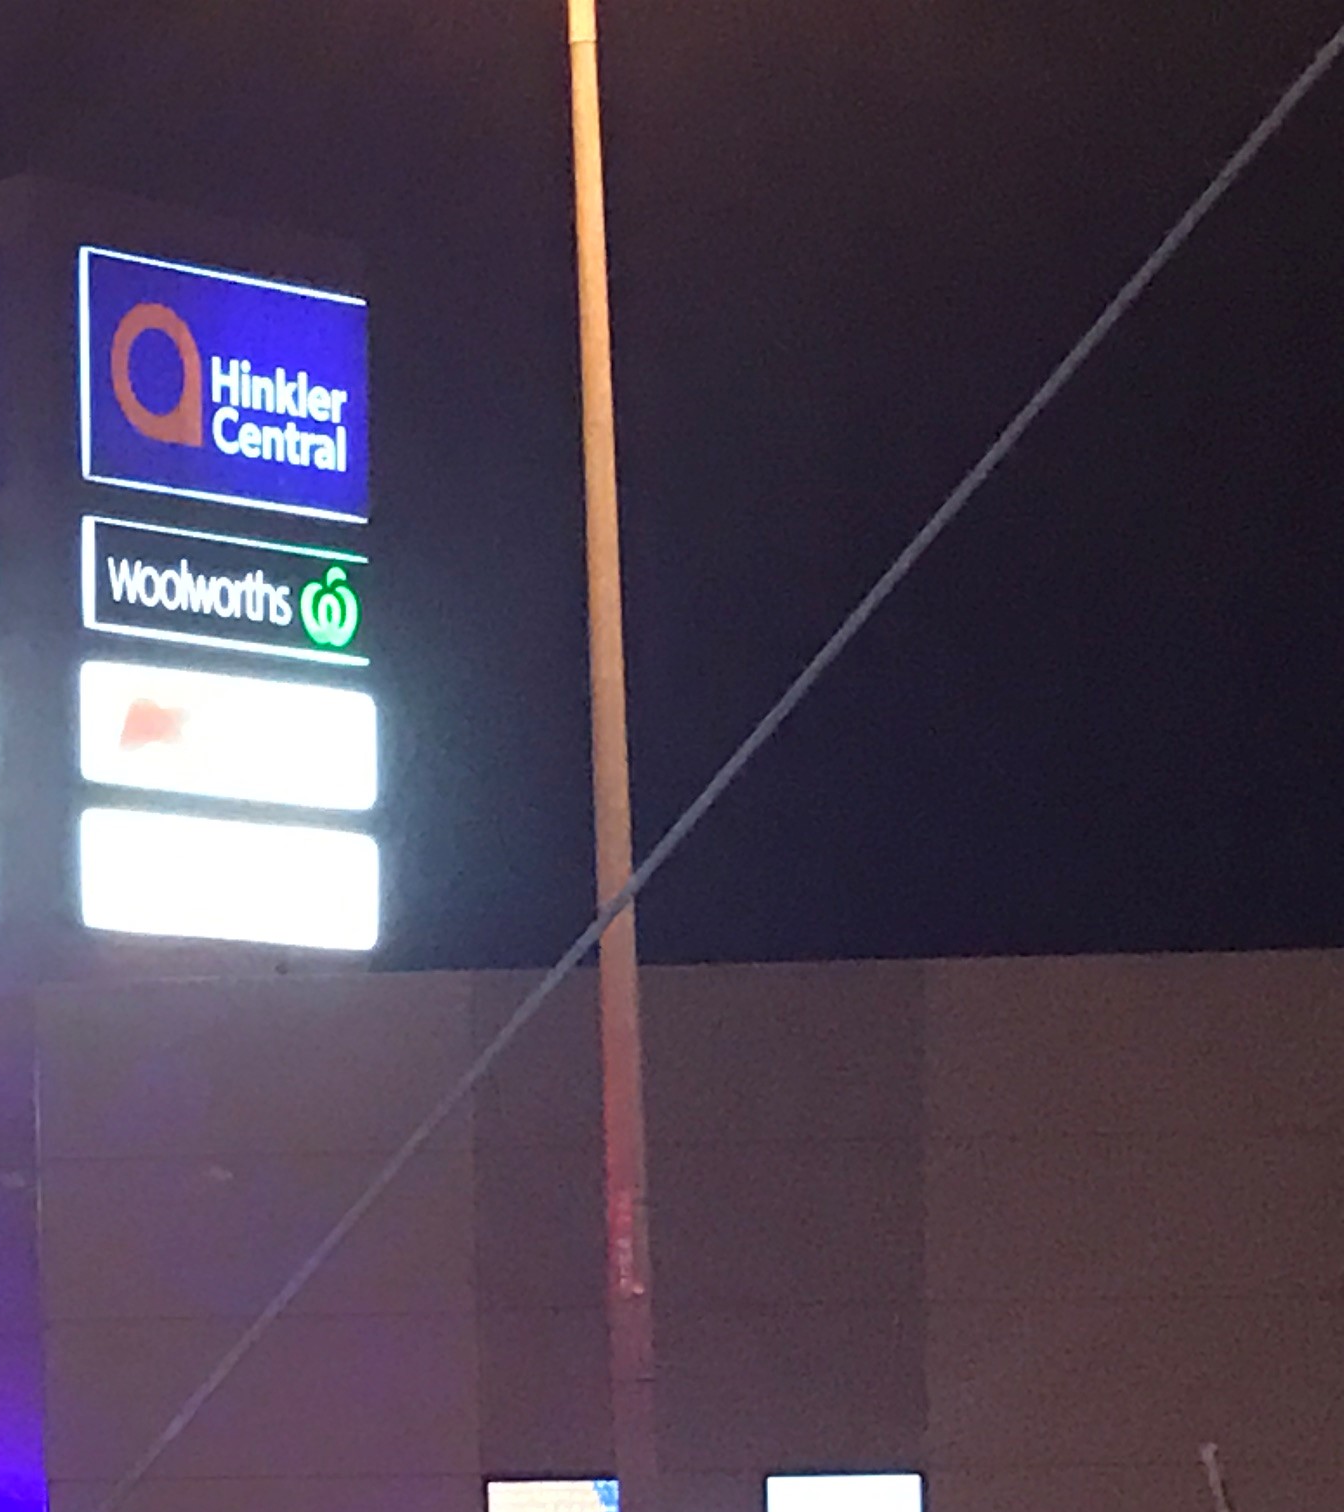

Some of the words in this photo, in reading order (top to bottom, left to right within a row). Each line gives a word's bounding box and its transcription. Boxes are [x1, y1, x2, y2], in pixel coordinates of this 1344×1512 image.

[210, 356, 348, 424] Hinkler
[211, 407, 348, 473] Central
[108, 556, 293, 626] Woolworths
